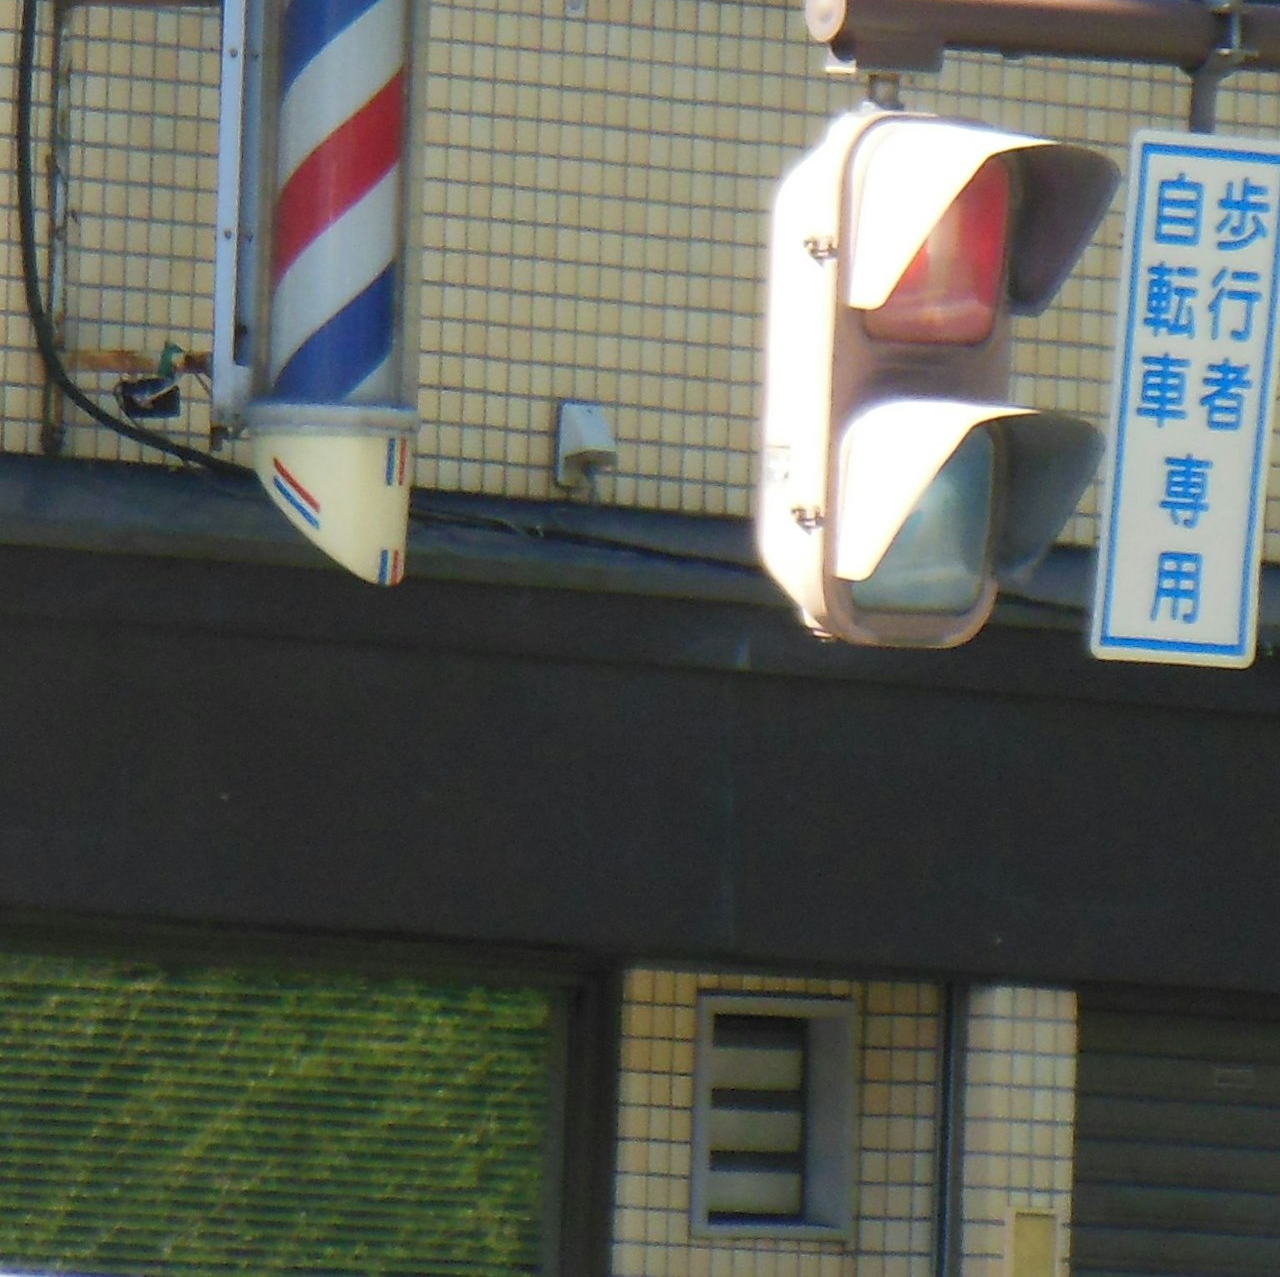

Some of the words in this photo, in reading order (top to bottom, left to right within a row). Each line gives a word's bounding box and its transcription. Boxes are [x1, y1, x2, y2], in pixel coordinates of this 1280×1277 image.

[1135, 171, 1205, 429] 自転車
[1199, 176, 1272, 433] 歩行者
[1149, 451, 1214, 625] 専用
